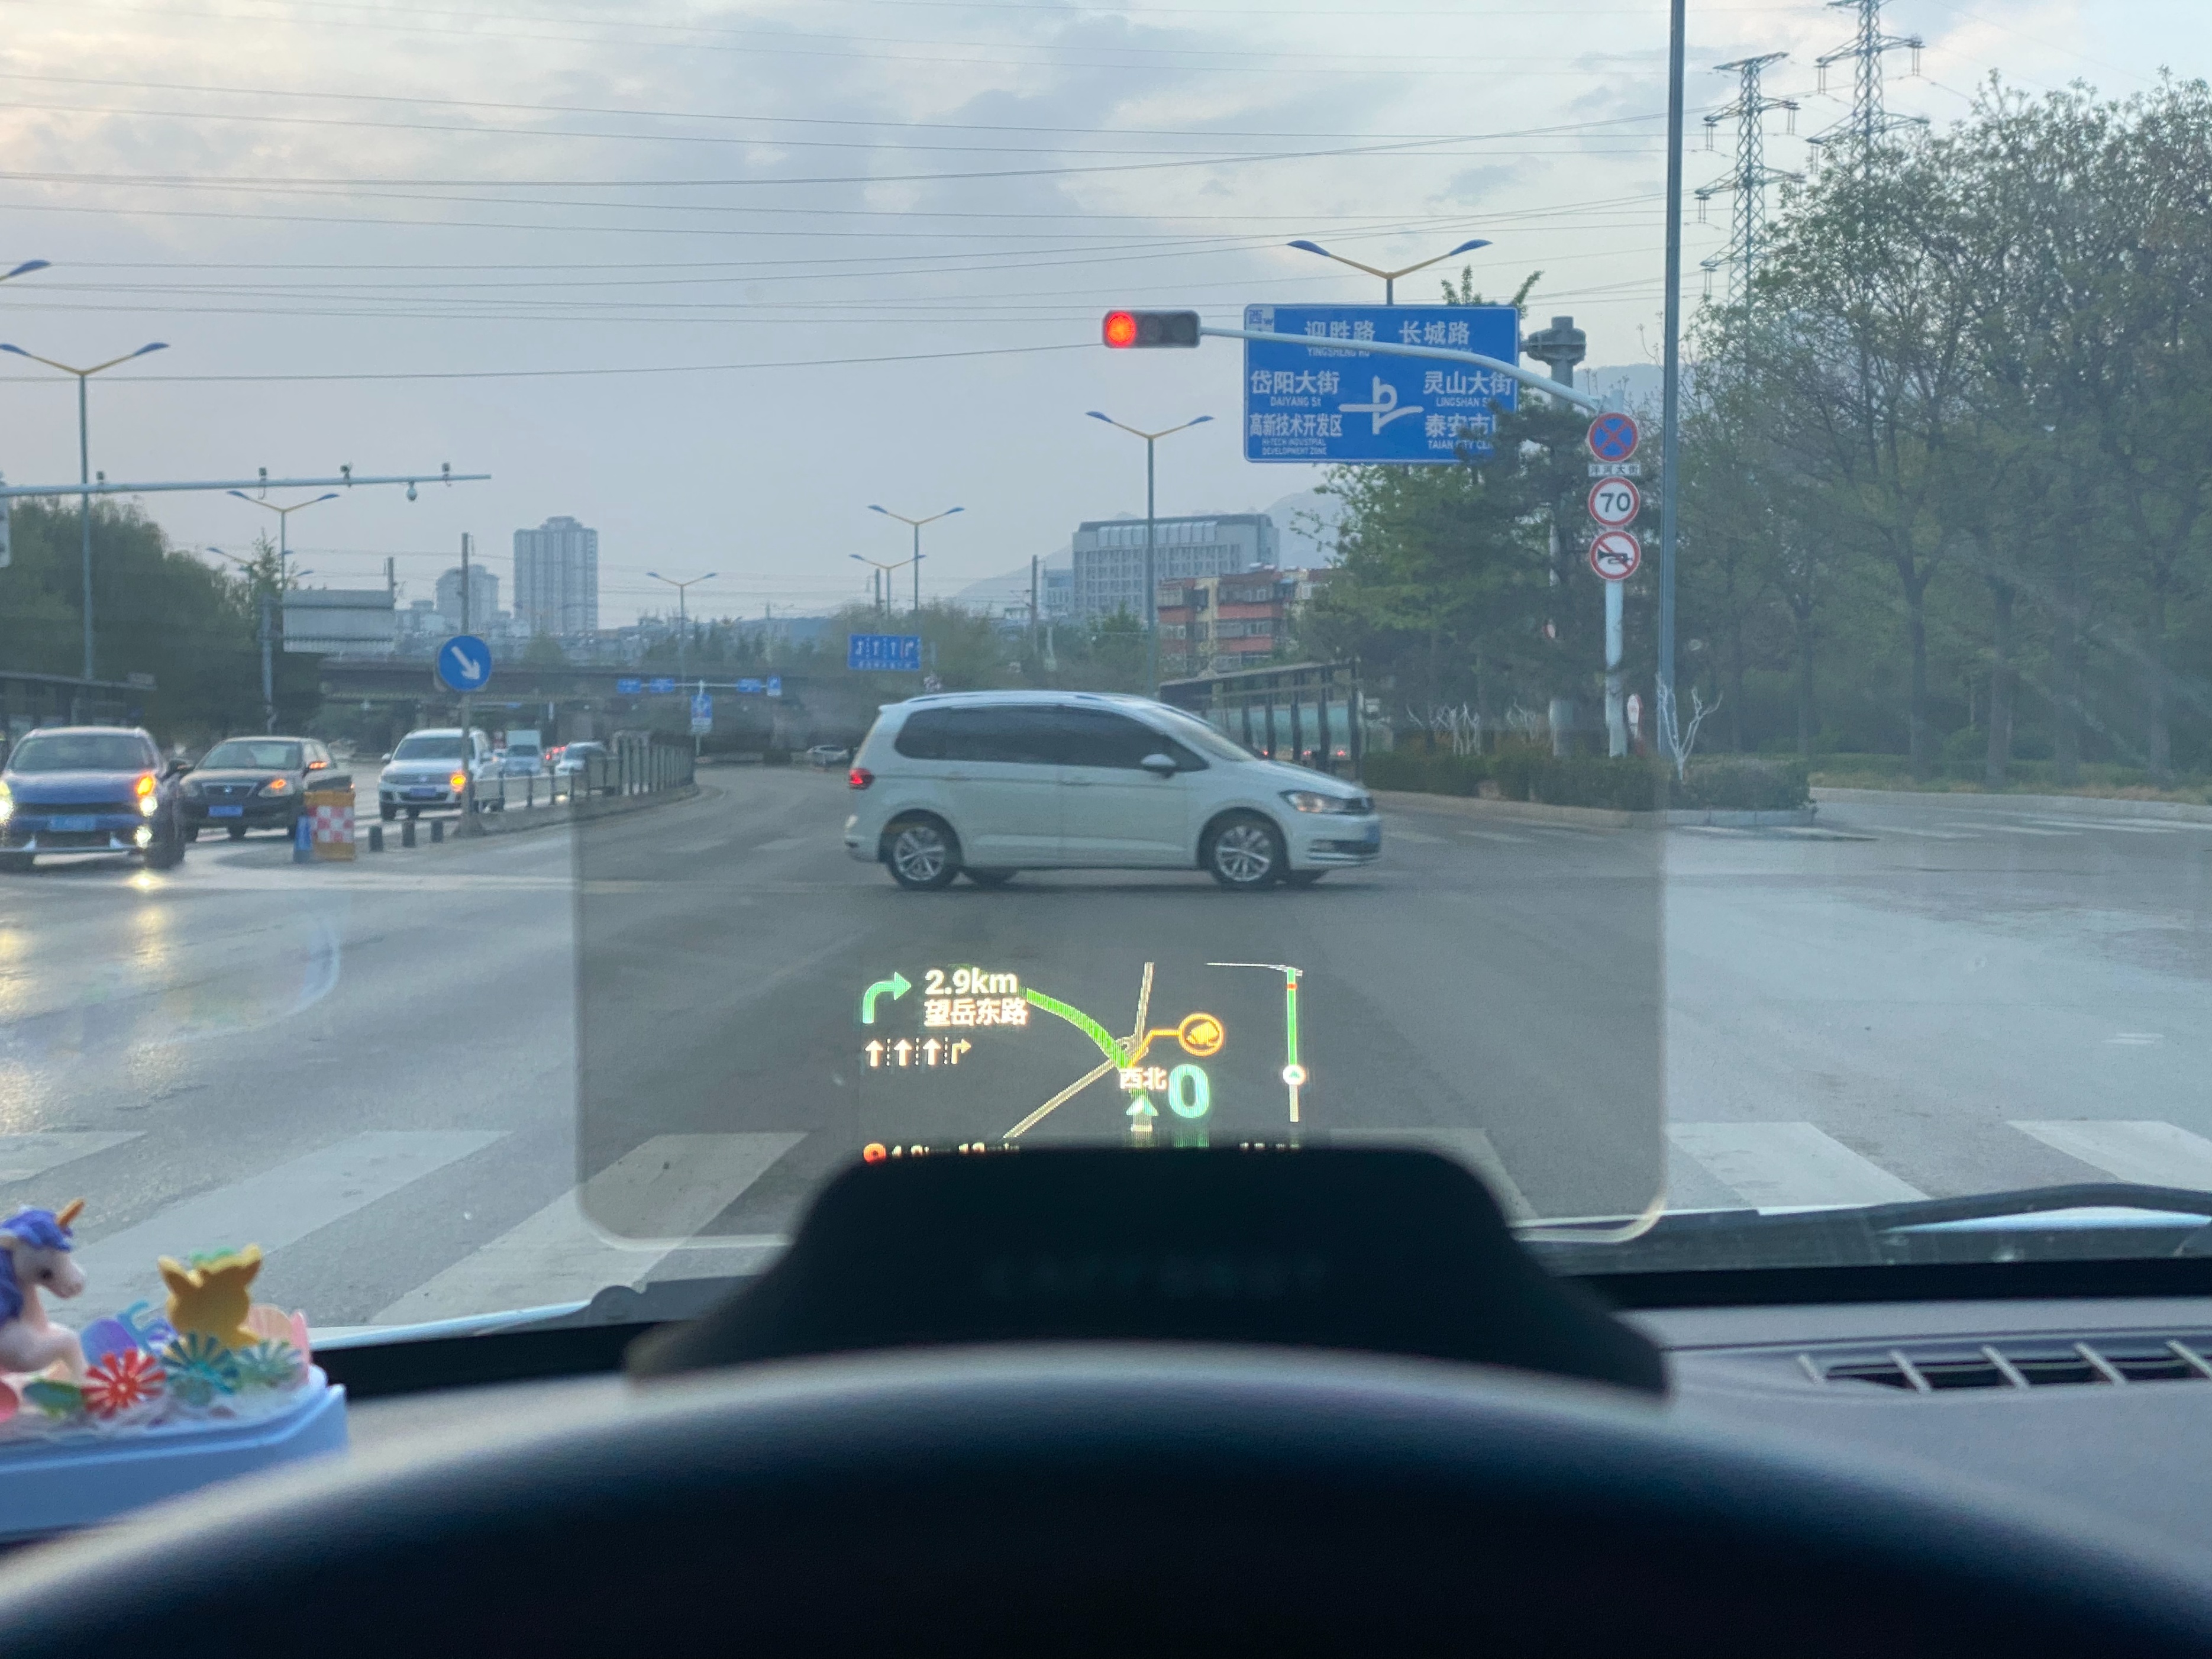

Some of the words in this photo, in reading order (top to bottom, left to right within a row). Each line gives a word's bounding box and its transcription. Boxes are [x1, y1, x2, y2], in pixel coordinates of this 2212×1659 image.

[1304, 320, 1375, 341] 迎胜路
[1399, 320, 1470, 345] 长城路
[1250, 370, 1340, 395] 岱阳大街
[1423, 370, 1512, 396] 灵山大街
[1270, 396, 1309, 406] DAIYANG
[1436, 397, 1480, 407] LINGSHAN
[1249, 413, 1343, 437] 高新技术开发区
[1425, 413, 1496, 438] 泰安市
[1428, 440, 1454, 449] TAIAN
[1600, 492, 1630, 512] 70
[924, 967, 1018, 995] 2.9km
[923, 997, 1028, 1027] 望岳东路
[1119, 1066, 1168, 1090] 西北
[1168, 1063, 1210, 1119] 0
